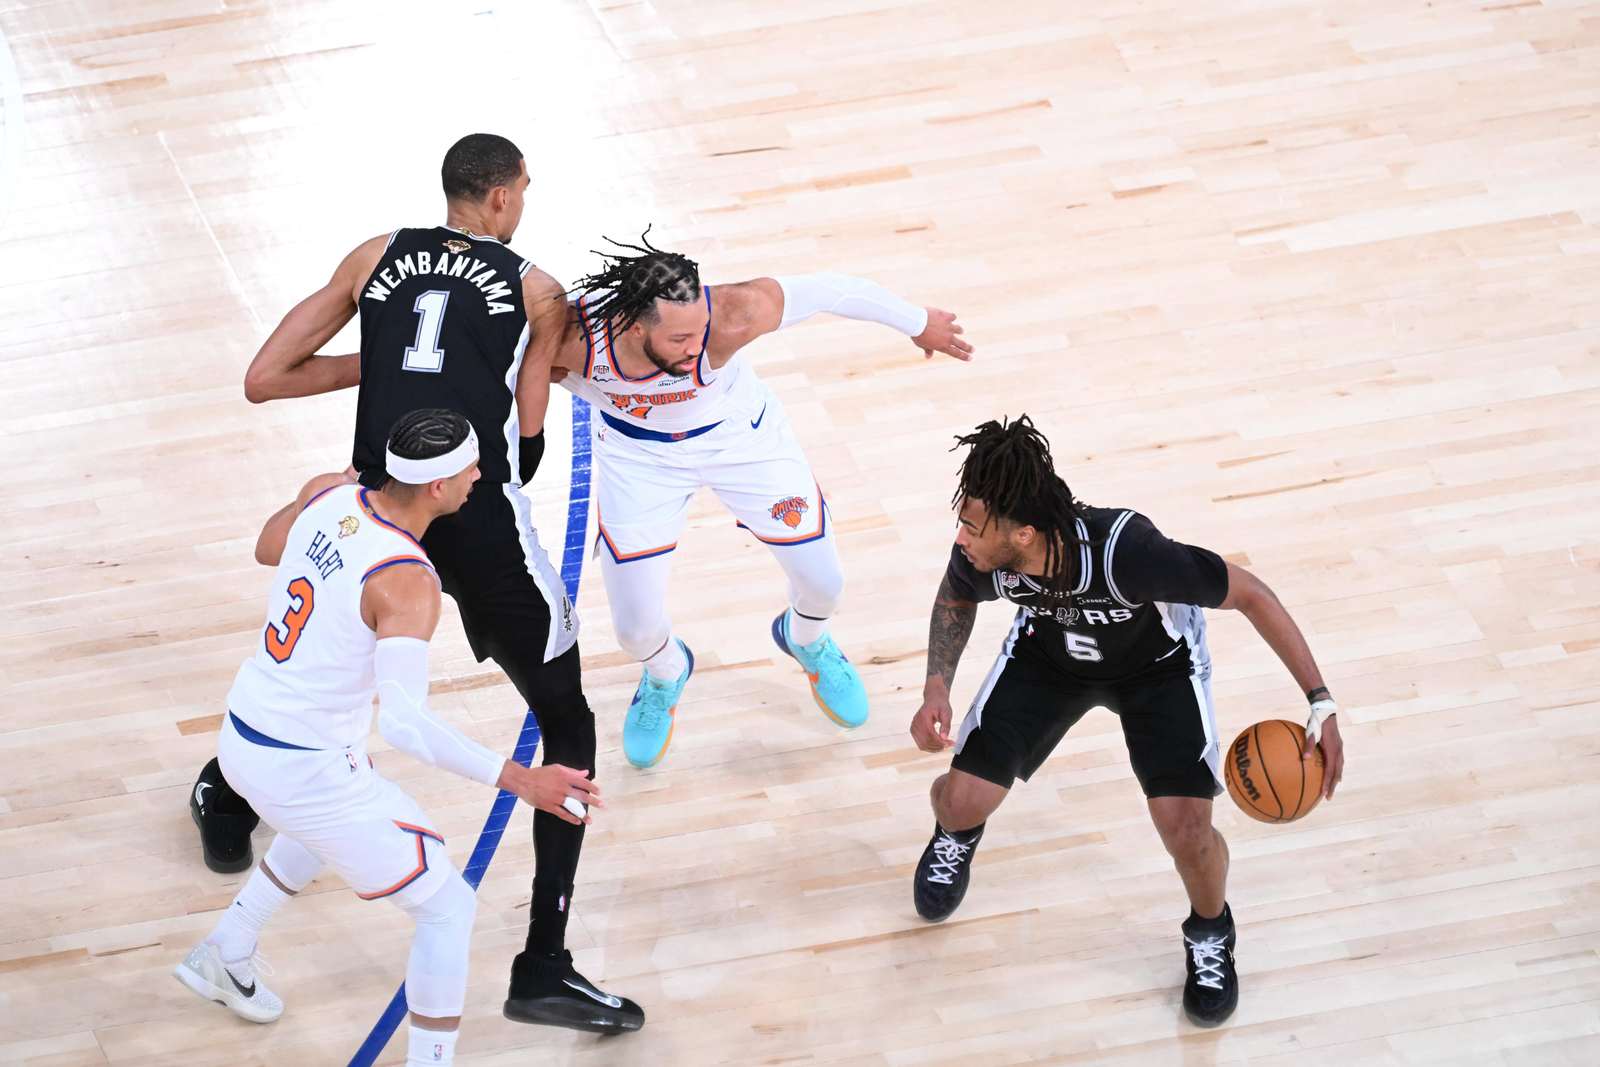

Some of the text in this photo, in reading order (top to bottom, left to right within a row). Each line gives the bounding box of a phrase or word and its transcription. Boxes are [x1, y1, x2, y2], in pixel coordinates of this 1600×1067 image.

[365, 251, 515, 315] WEMBANYAMA
[402, 289, 450, 373] 1
[631, 388, 698, 405] YORK
[771, 496, 809, 519] KNICKS
[305, 530, 344, 581] HART
[264, 576, 315, 664] 3
[1063, 631, 1104, 662] 5
[1235, 733, 1261, 802] Wilson
